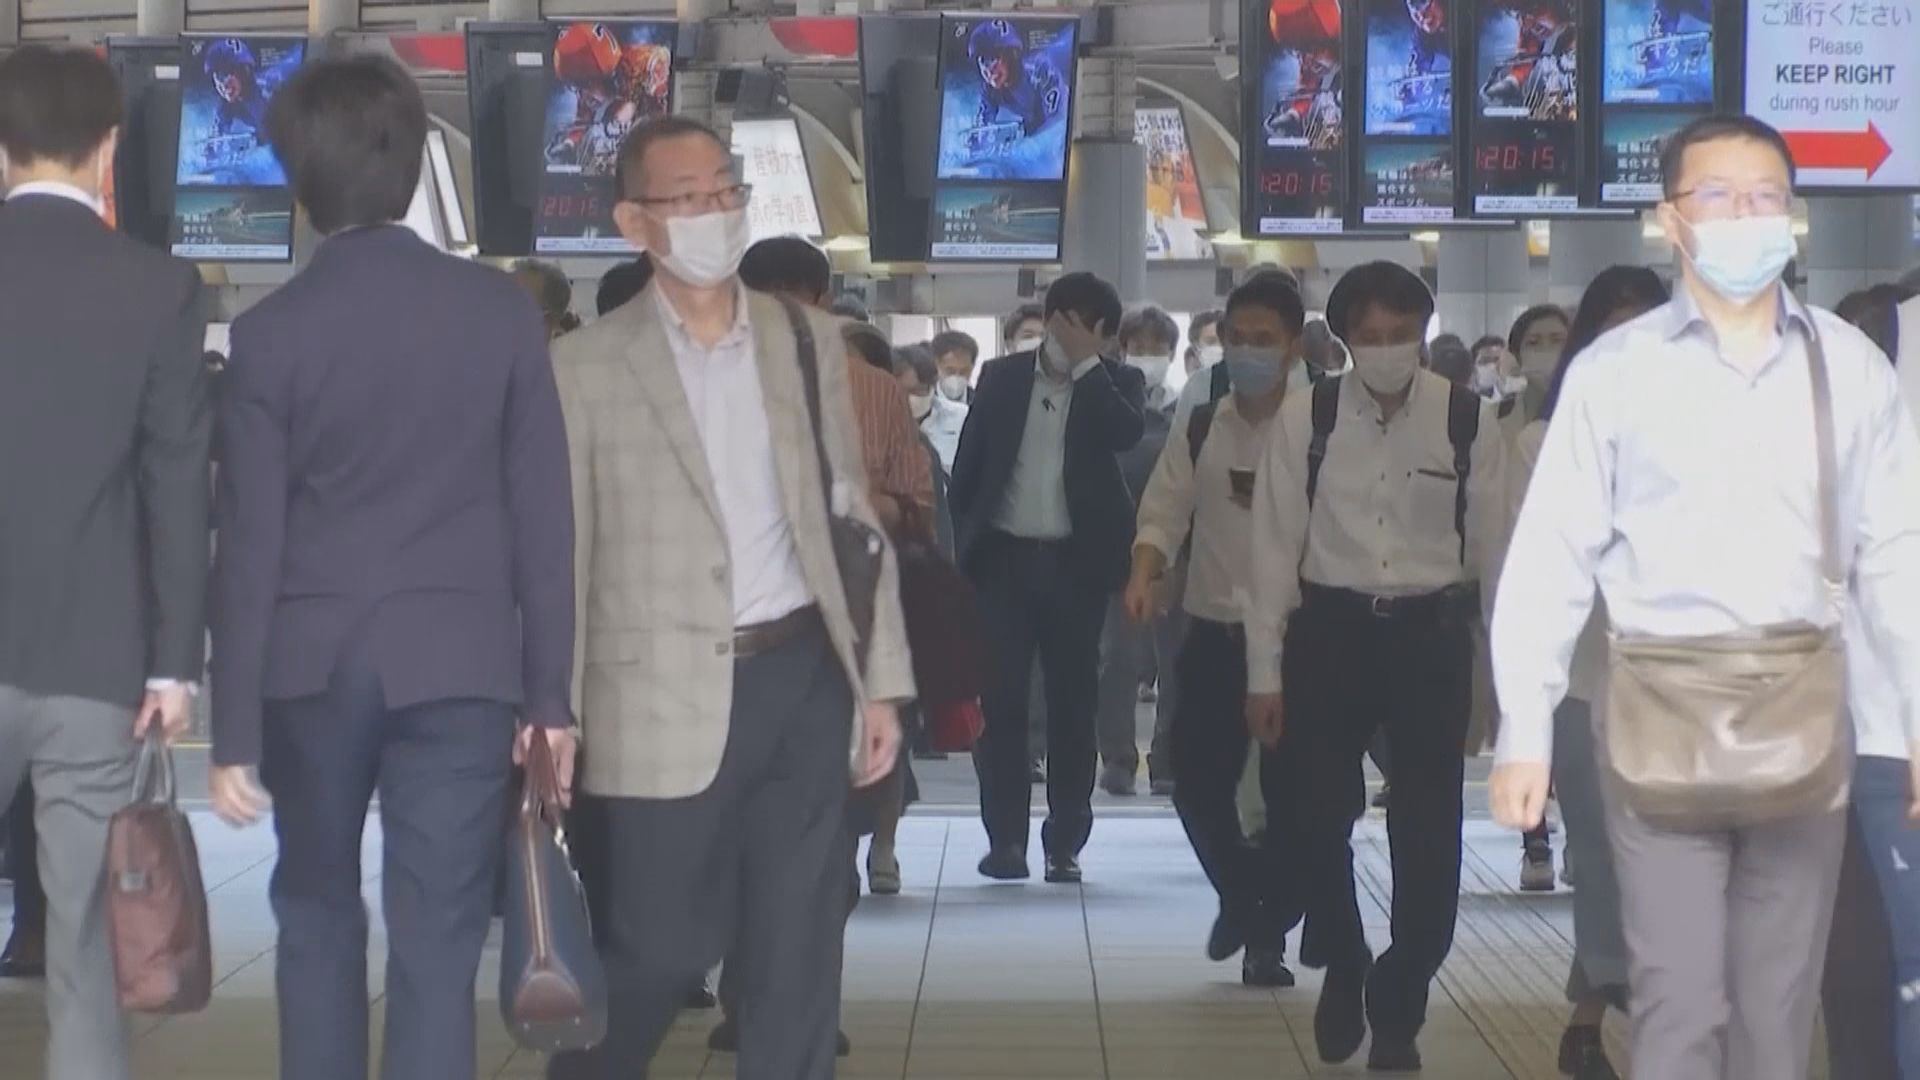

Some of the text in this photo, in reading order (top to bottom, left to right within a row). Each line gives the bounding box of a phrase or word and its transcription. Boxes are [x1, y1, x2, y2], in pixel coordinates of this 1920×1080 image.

[1762, 2, 1912, 27] ご通行ください
[1809, 36, 1863, 55] Please
[1776, 64, 1896, 85] KEEP RIGHT
[1769, 94, 1900, 115] during rush hour
